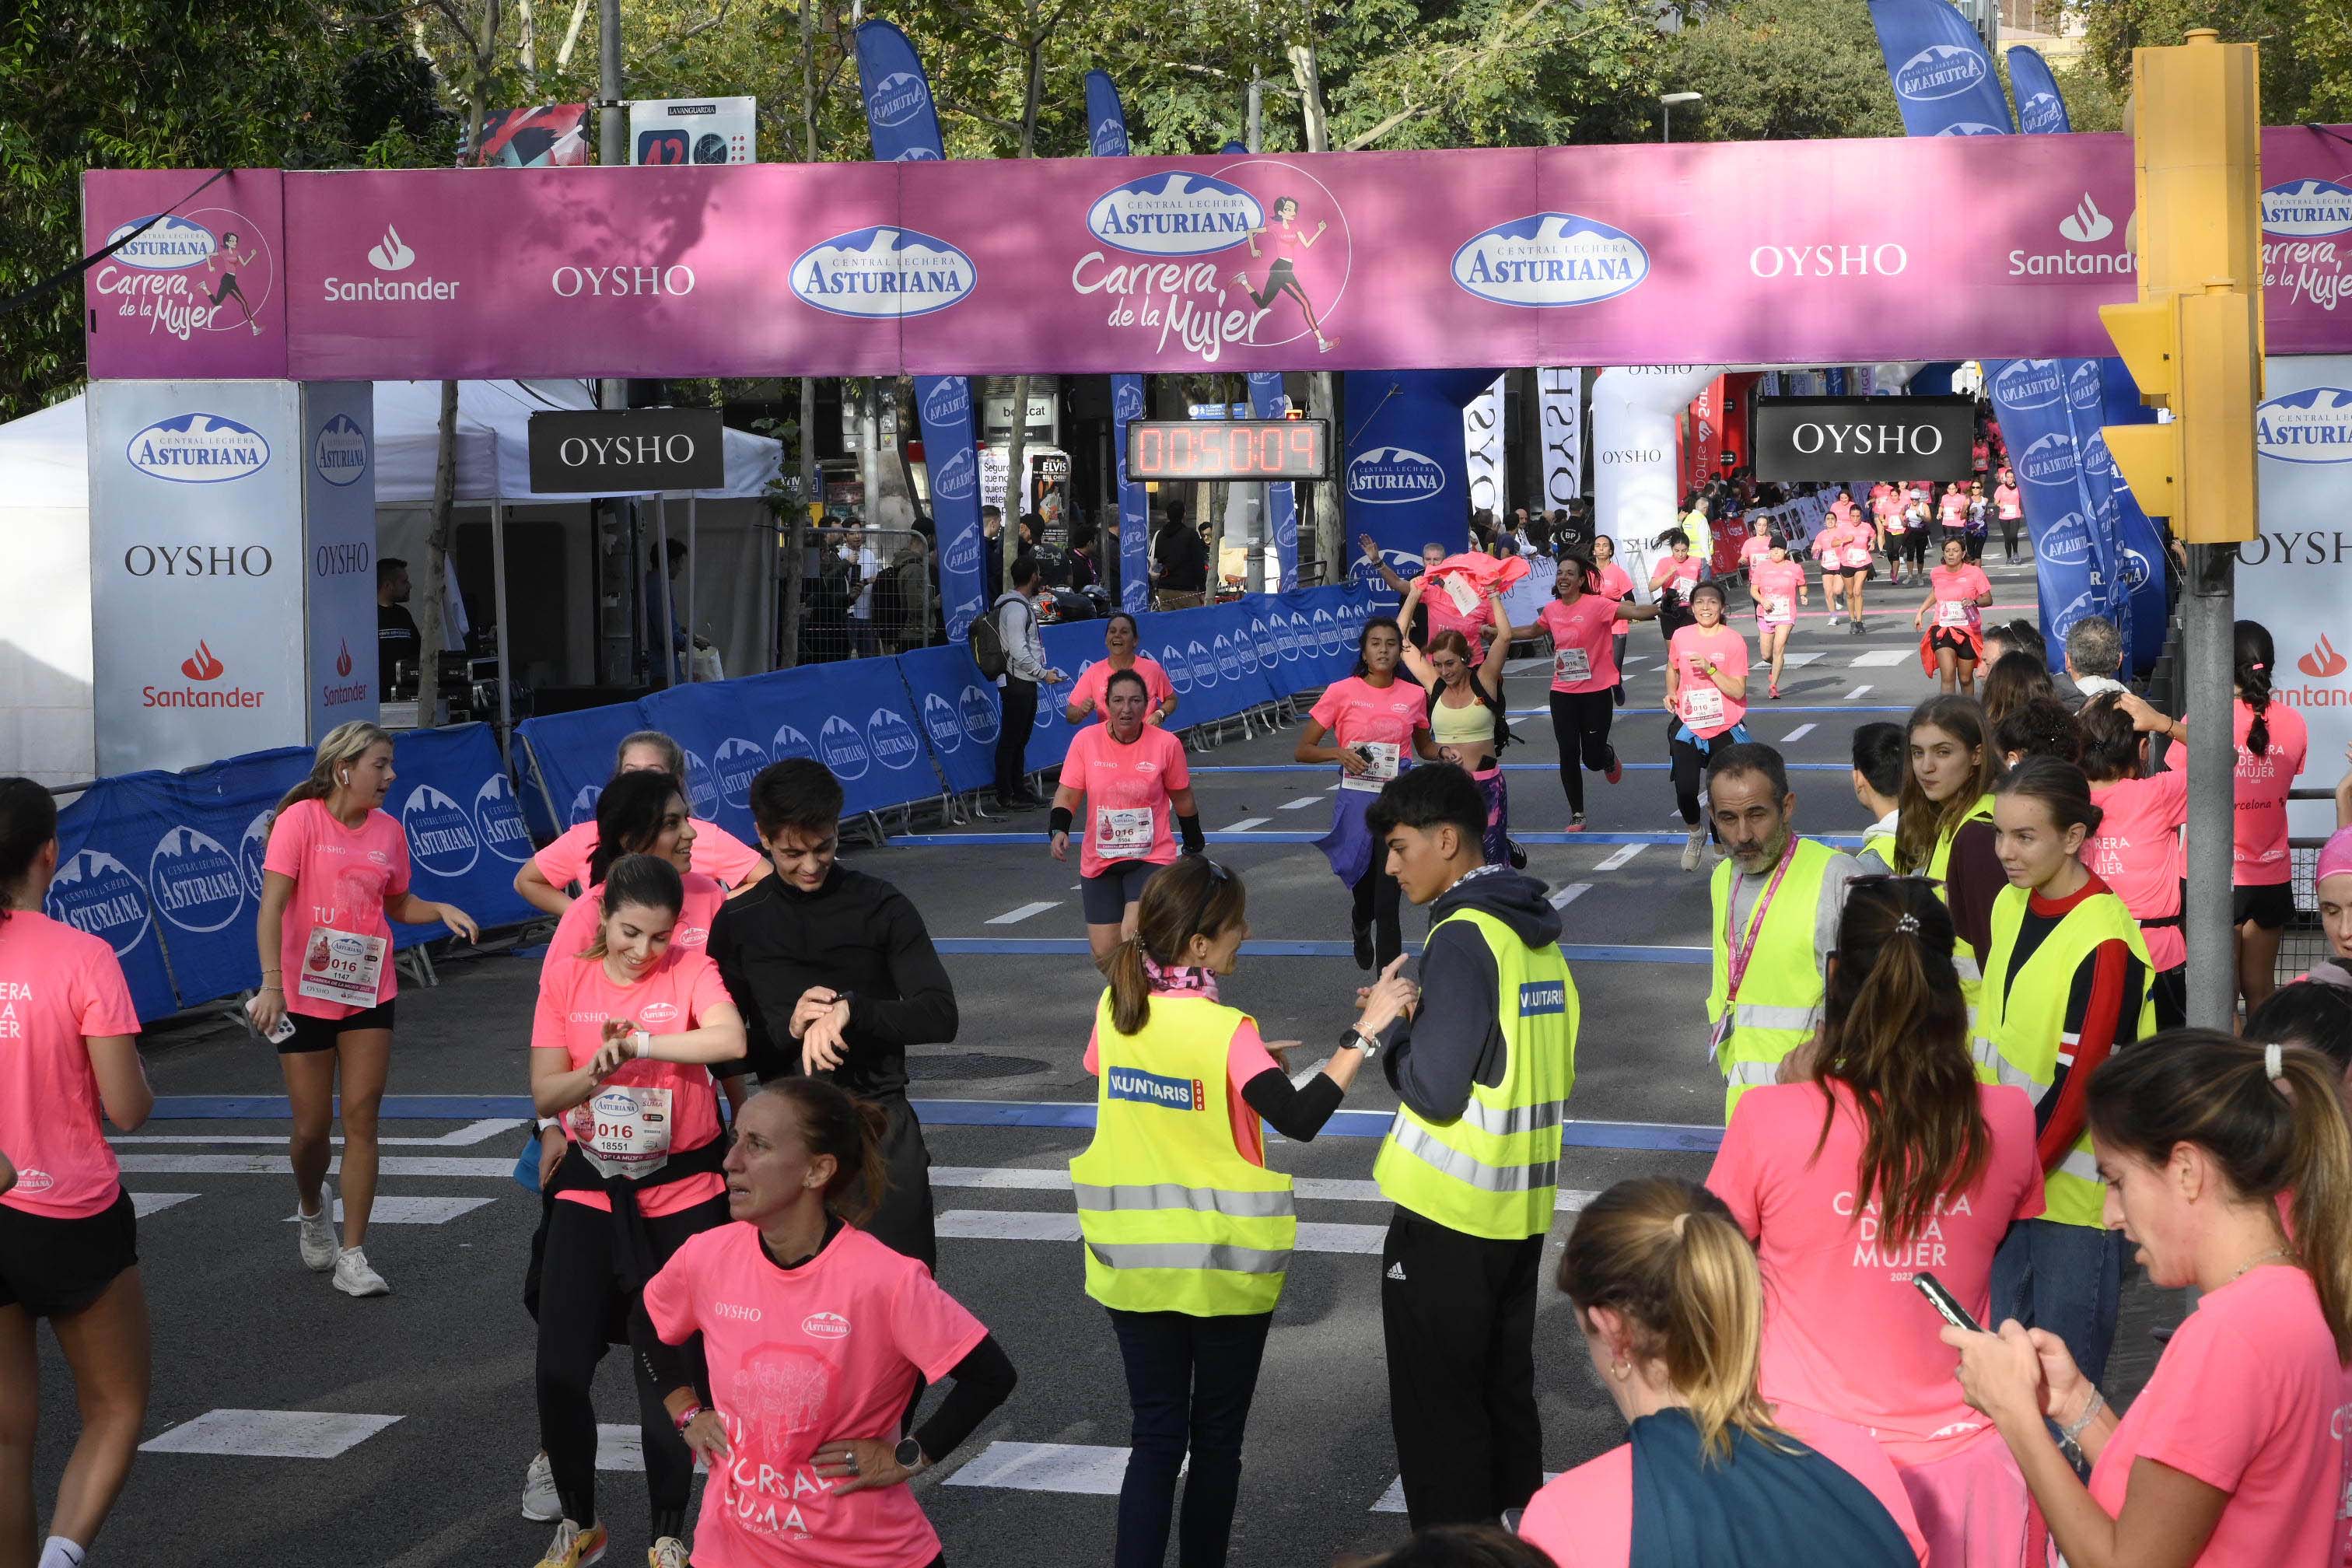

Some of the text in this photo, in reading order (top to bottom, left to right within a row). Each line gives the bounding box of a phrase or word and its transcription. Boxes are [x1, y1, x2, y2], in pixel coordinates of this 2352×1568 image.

[1128, 199, 1244, 208] CENTRAL LECHERA
[1101, 203, 1249, 234] ASTURIANA
[1497, 244, 1628, 255] CENTRAL LECHERA
[1749, 243, 1907, 277] OYSHO
[2261, 241, 2336, 264] arrera
[832, 256, 957, 267] CENTRAL LECHERA
[1467, 249, 1633, 283] ASTURIANA
[96, 265, 187, 296] Carrera
[551, 264, 695, 297] OYSHO
[803, 259, 962, 294] ASTURIANA
[1072, 251, 1217, 295] Carrera
[2280, 265, 2294, 287] la
[324, 276, 460, 302] Santander
[118, 292, 223, 341] de la Mujer
[1108, 289, 1272, 362] de la Mujer
[2278, 414, 2330, 422] CENTRAL
[159, 436, 205, 445] CENTRAL
[1792, 423, 1942, 455] OYSHO
[138, 439, 260, 465] ASTURIANA
[320, 443, 364, 468] ASTURIANA
[560, 434, 695, 467] OYSHO
[1139, 429, 1314, 472] 00:50:09
[1602, 449, 1661, 464] OYSHO
[1042, 462, 1066, 471] ELVIS
[1350, 470, 1437, 490] ASTURIANA
[124, 545, 272, 577] OYSHO
[317, 541, 369, 577] OYSHO
[143, 686, 264, 708] Santander
[324, 681, 367, 708] Santander
[2238, 756, 2273, 765] DE LA
[2235, 767, 2274, 778] MUJER
[2234, 799, 2271, 810] rcelona
[409, 821, 476, 858] ASTURIANA
[315, 845, 345, 856] OYSHO
[2102, 850, 2119, 862] LA
[159, 870, 241, 911] ASTURIANA
[313, 905, 335, 924] TU
[331, 958, 357, 972] 016
[306, 985, 330, 994] OYSHO
[569, 1012, 609, 1022] OYSHO
[643, 1010, 677, 1019] ASTURIANA
[597, 1101, 635, 1112] ASTURIANA
[599, 1123, 633, 1139] 016
[602, 1142, 628, 1151] 18551
[1853, 1243, 1948, 1268] MUJER
[1891, 1272, 1913, 1282] 2023
[714, 1302, 761, 1322] OYSHO
[806, 1319, 848, 1334] ASTURIANA
